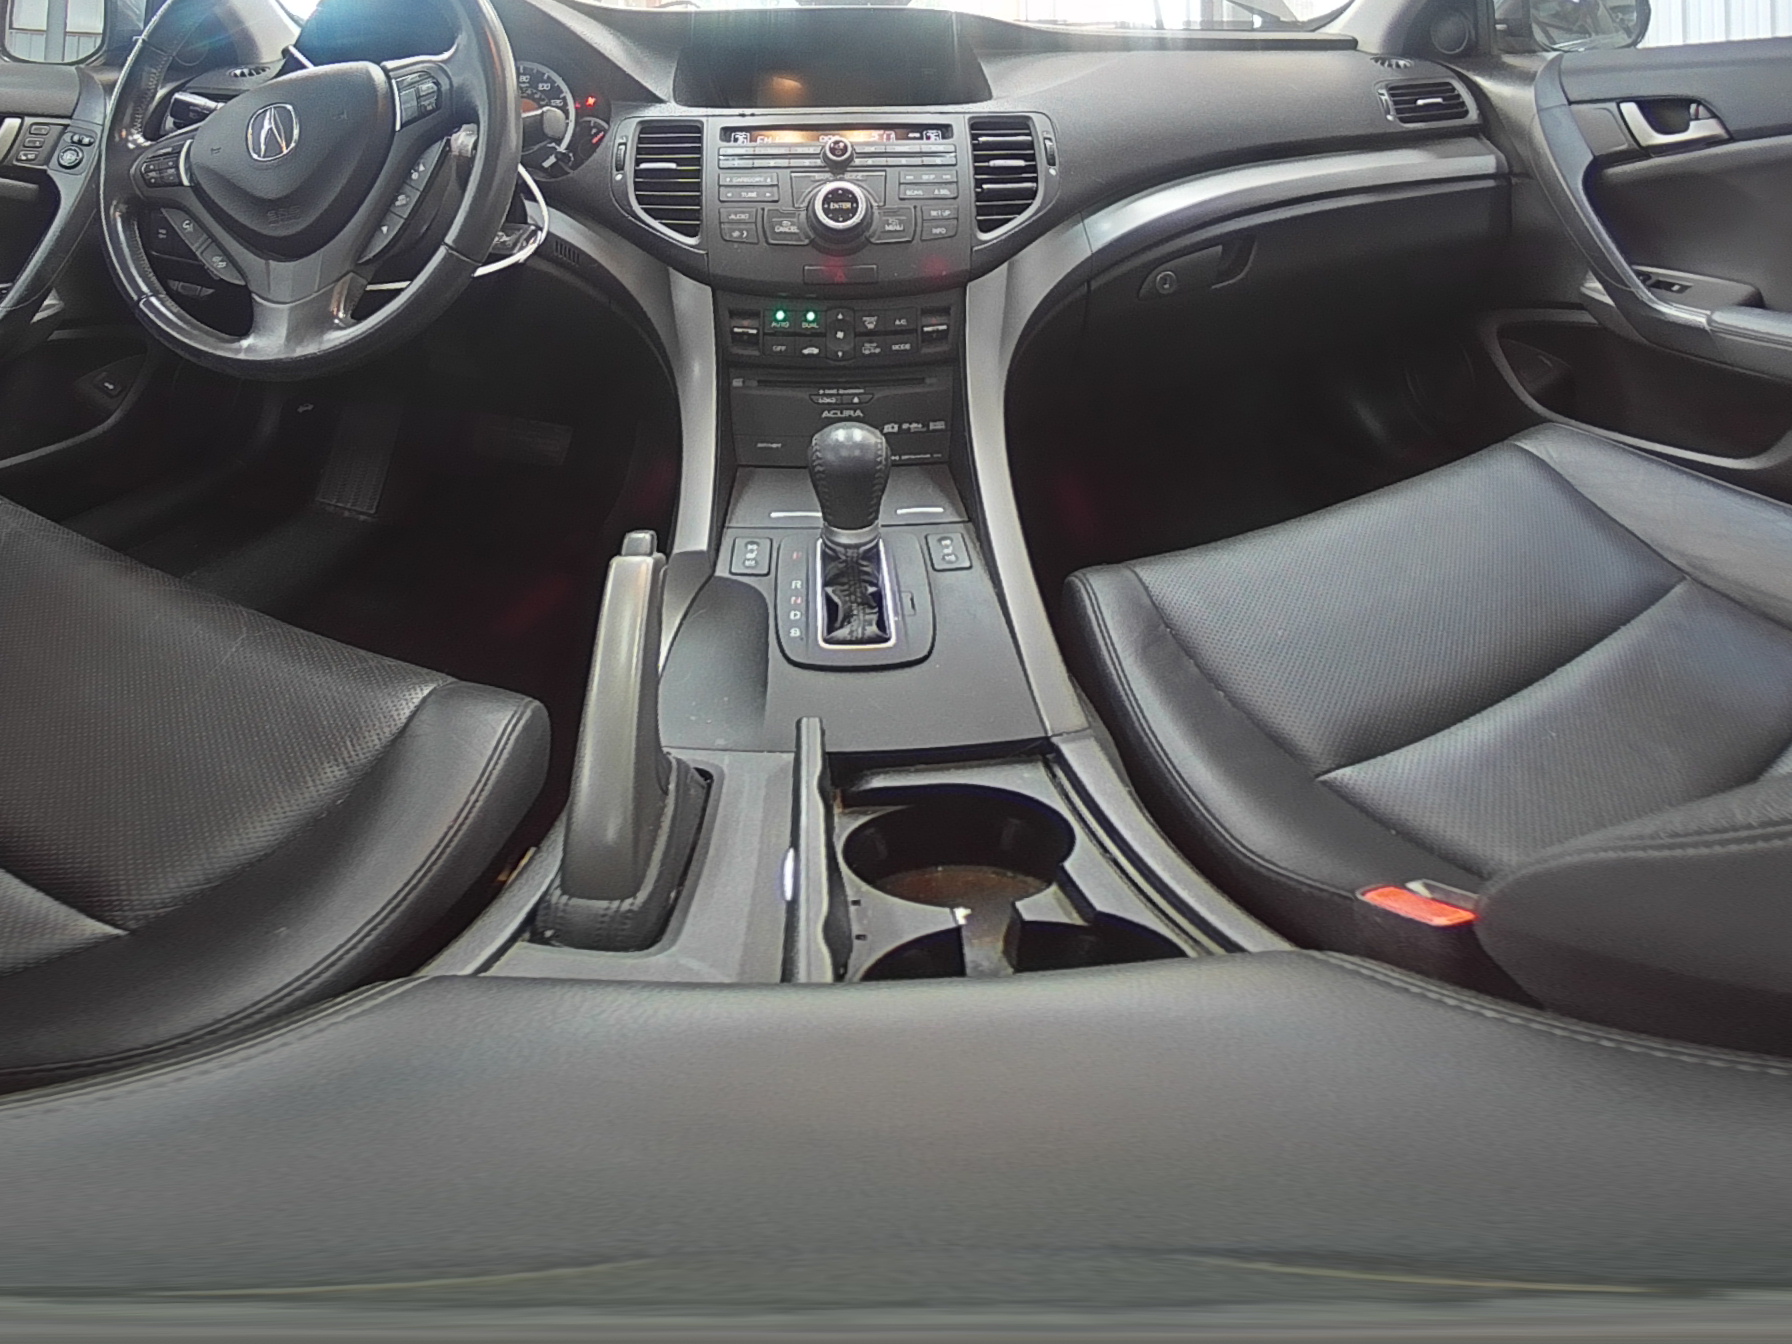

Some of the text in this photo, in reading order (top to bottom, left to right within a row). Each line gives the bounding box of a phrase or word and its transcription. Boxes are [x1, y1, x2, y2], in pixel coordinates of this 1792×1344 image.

[822, 410, 864, 418] ACURA
[791, 580, 802, 589] R
[790, 610, 801, 620] D
